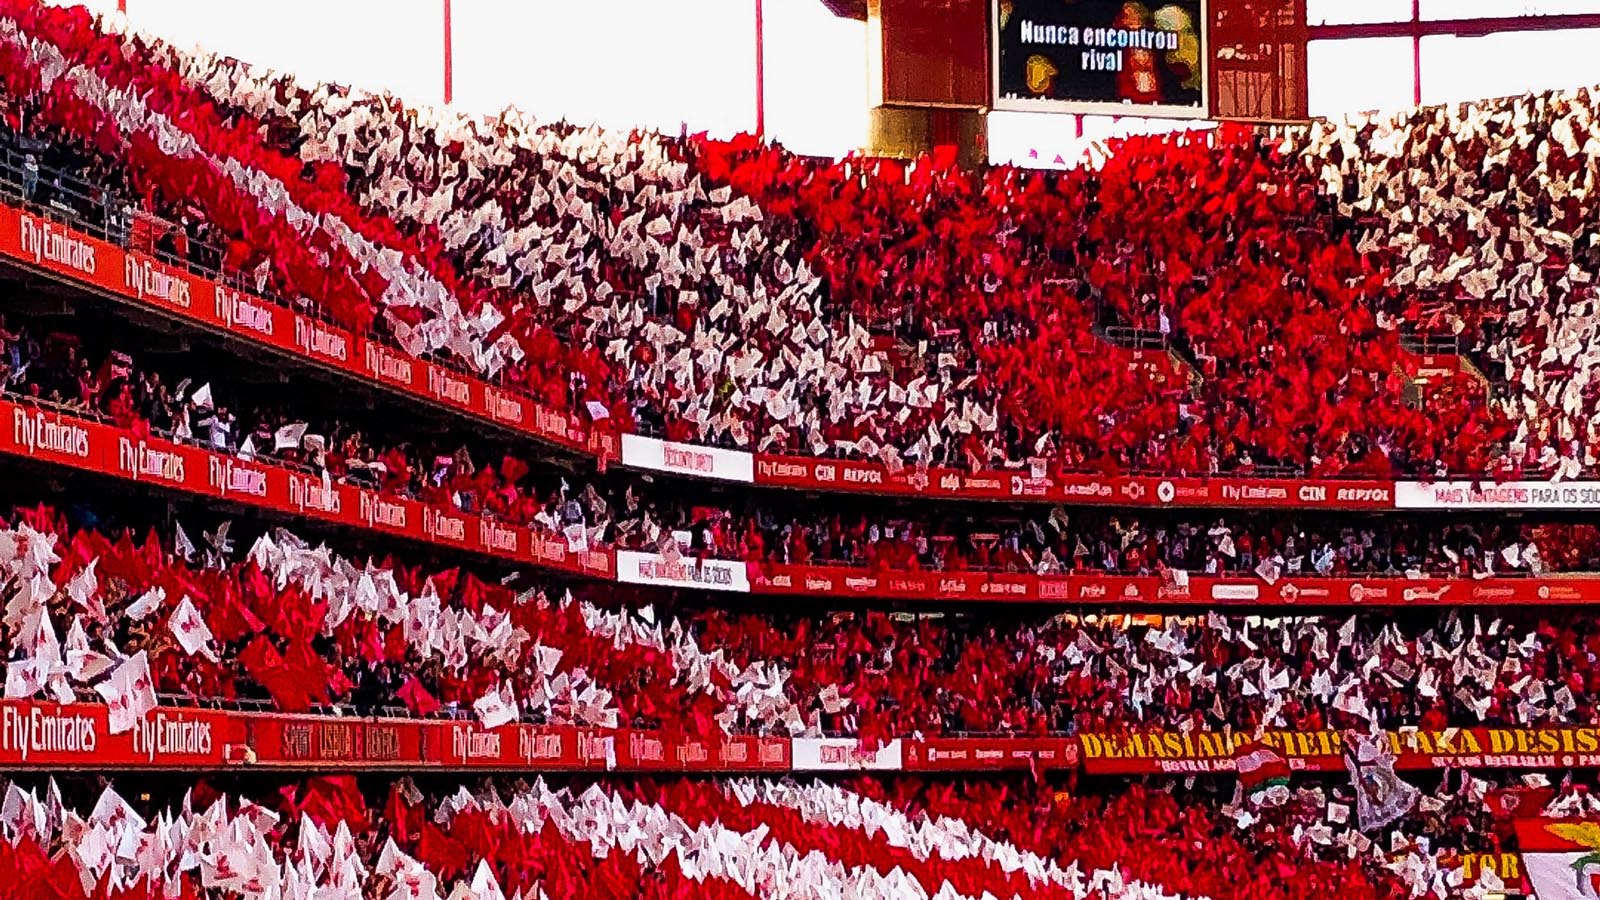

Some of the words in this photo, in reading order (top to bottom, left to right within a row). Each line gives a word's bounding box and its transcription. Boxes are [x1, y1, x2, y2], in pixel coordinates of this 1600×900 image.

[1021, 19, 1079, 45] Nunca
[1083, 26, 1178, 49] encontrou
[1081, 48, 1123, 71] rival
